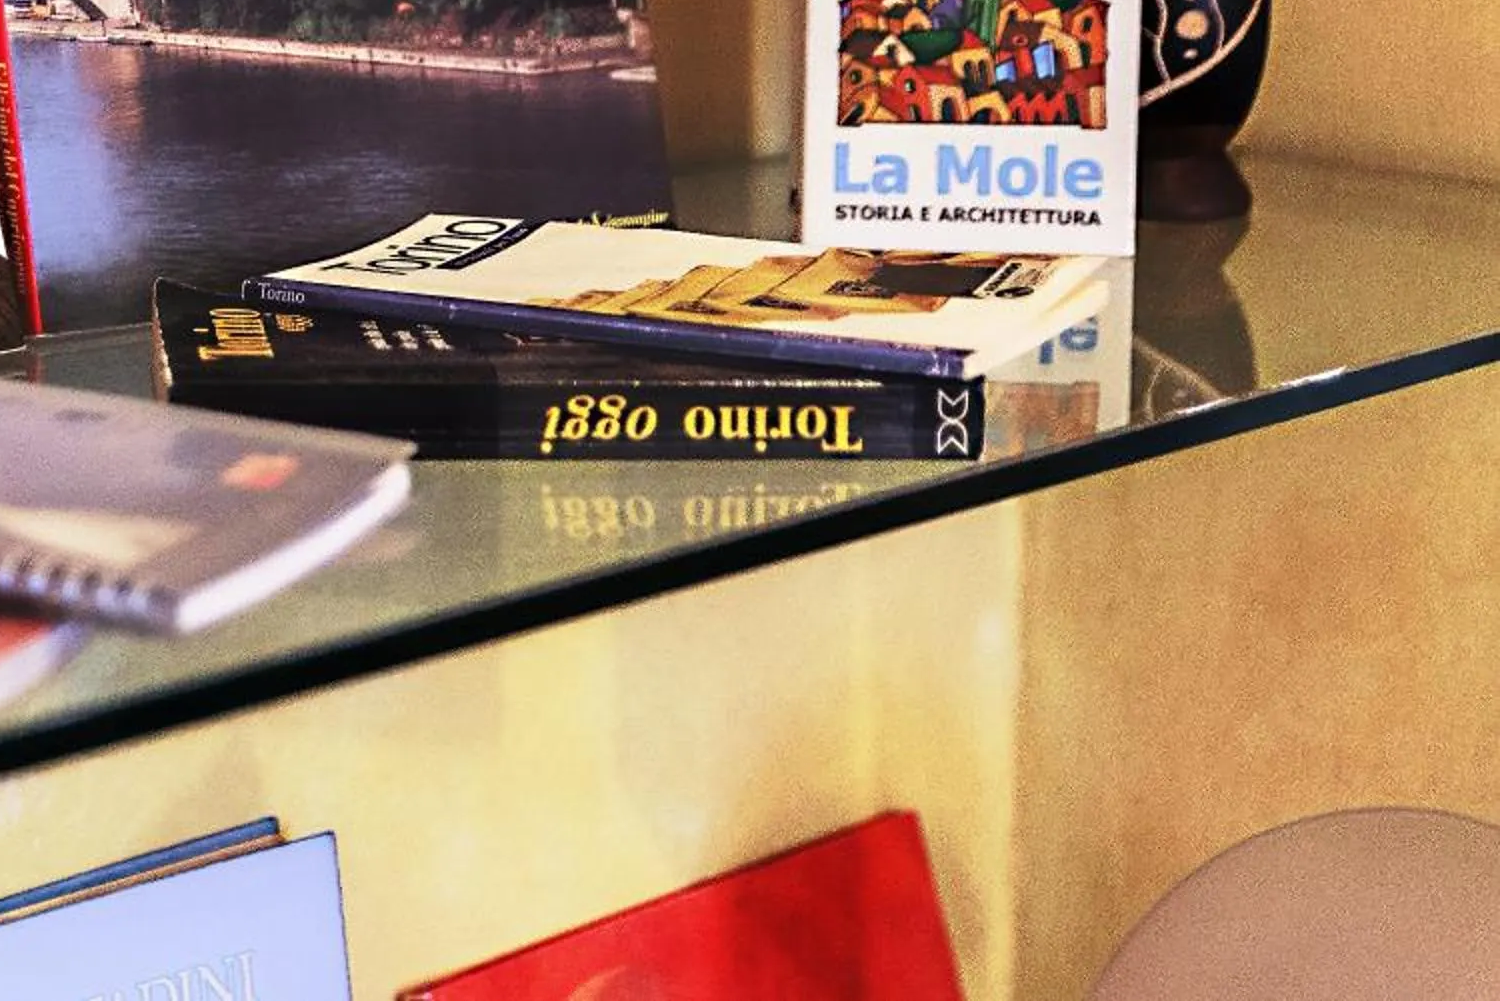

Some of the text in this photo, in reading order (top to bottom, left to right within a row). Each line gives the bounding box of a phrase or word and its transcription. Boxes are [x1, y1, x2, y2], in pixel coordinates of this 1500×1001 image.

[833, 142, 1104, 199] La Mole
[835, 204, 1101, 227] STORIA E ARCHITETTURA
[320, 219, 507, 276] Torino
[257, 282, 305, 305] Torino
[540, 393, 865, 455] Torino oggi
